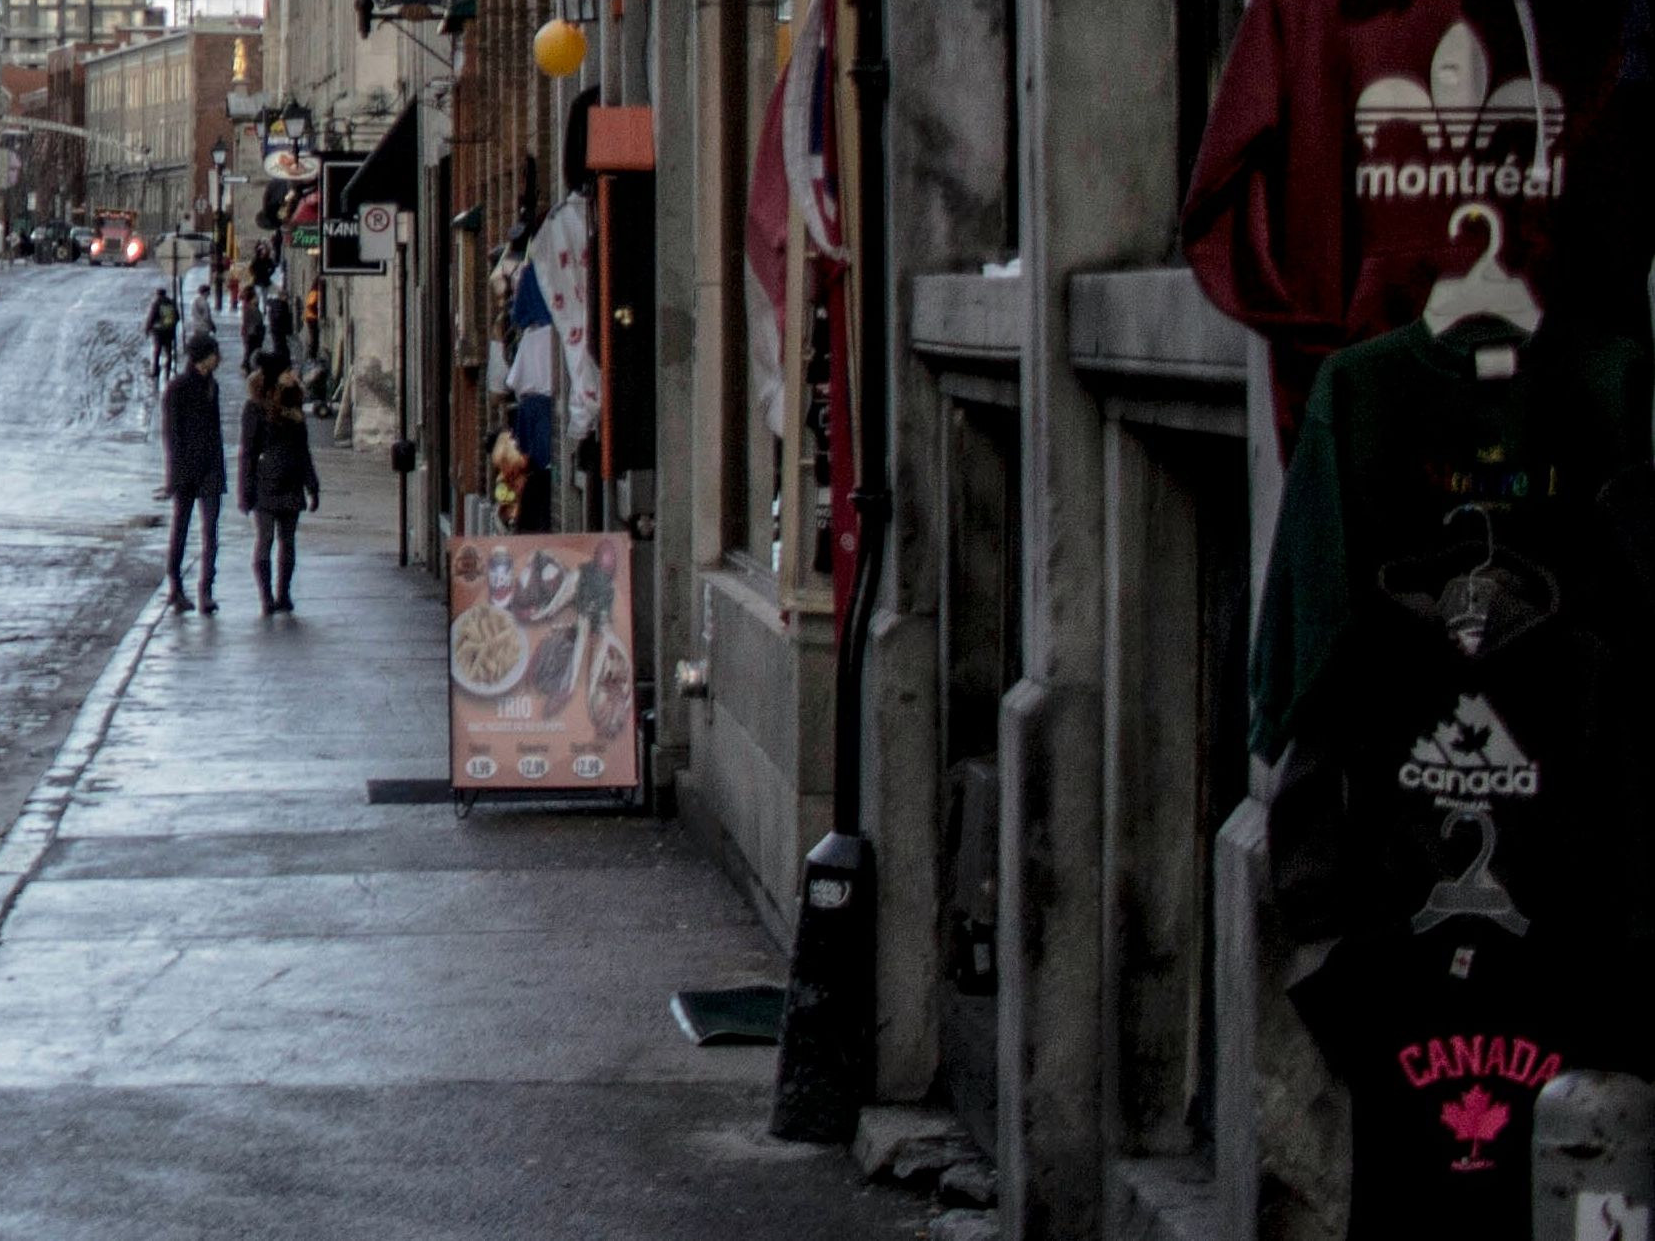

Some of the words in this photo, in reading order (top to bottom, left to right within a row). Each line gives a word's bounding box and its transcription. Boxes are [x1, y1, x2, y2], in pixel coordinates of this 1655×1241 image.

[1355, 153, 1567, 199] montréal
[1397, 761, 1538, 796] canada
[1397, 1035, 1563, 1090] CANADA
